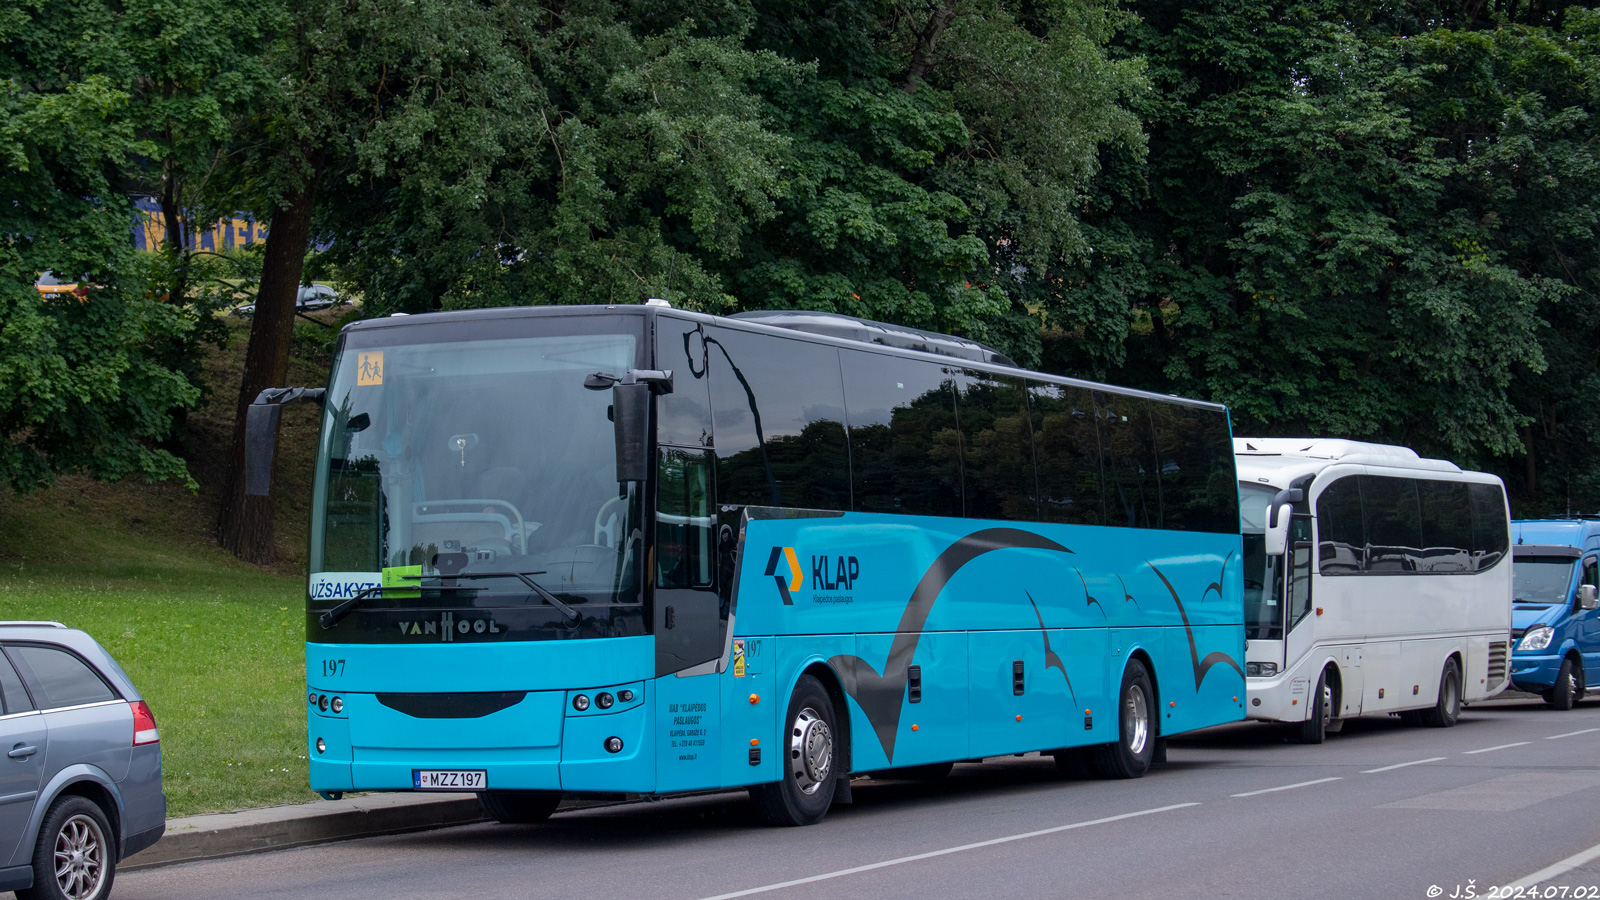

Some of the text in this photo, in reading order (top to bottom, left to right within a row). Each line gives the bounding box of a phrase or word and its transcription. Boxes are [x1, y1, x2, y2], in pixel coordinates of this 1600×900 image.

[812, 555, 859, 590] KLAP
[311, 578, 383, 598] UŽSAKYTA
[747, 640, 761, 657] 197
[322, 659, 346, 677] 197
[669, 703, 679, 712] UAB
